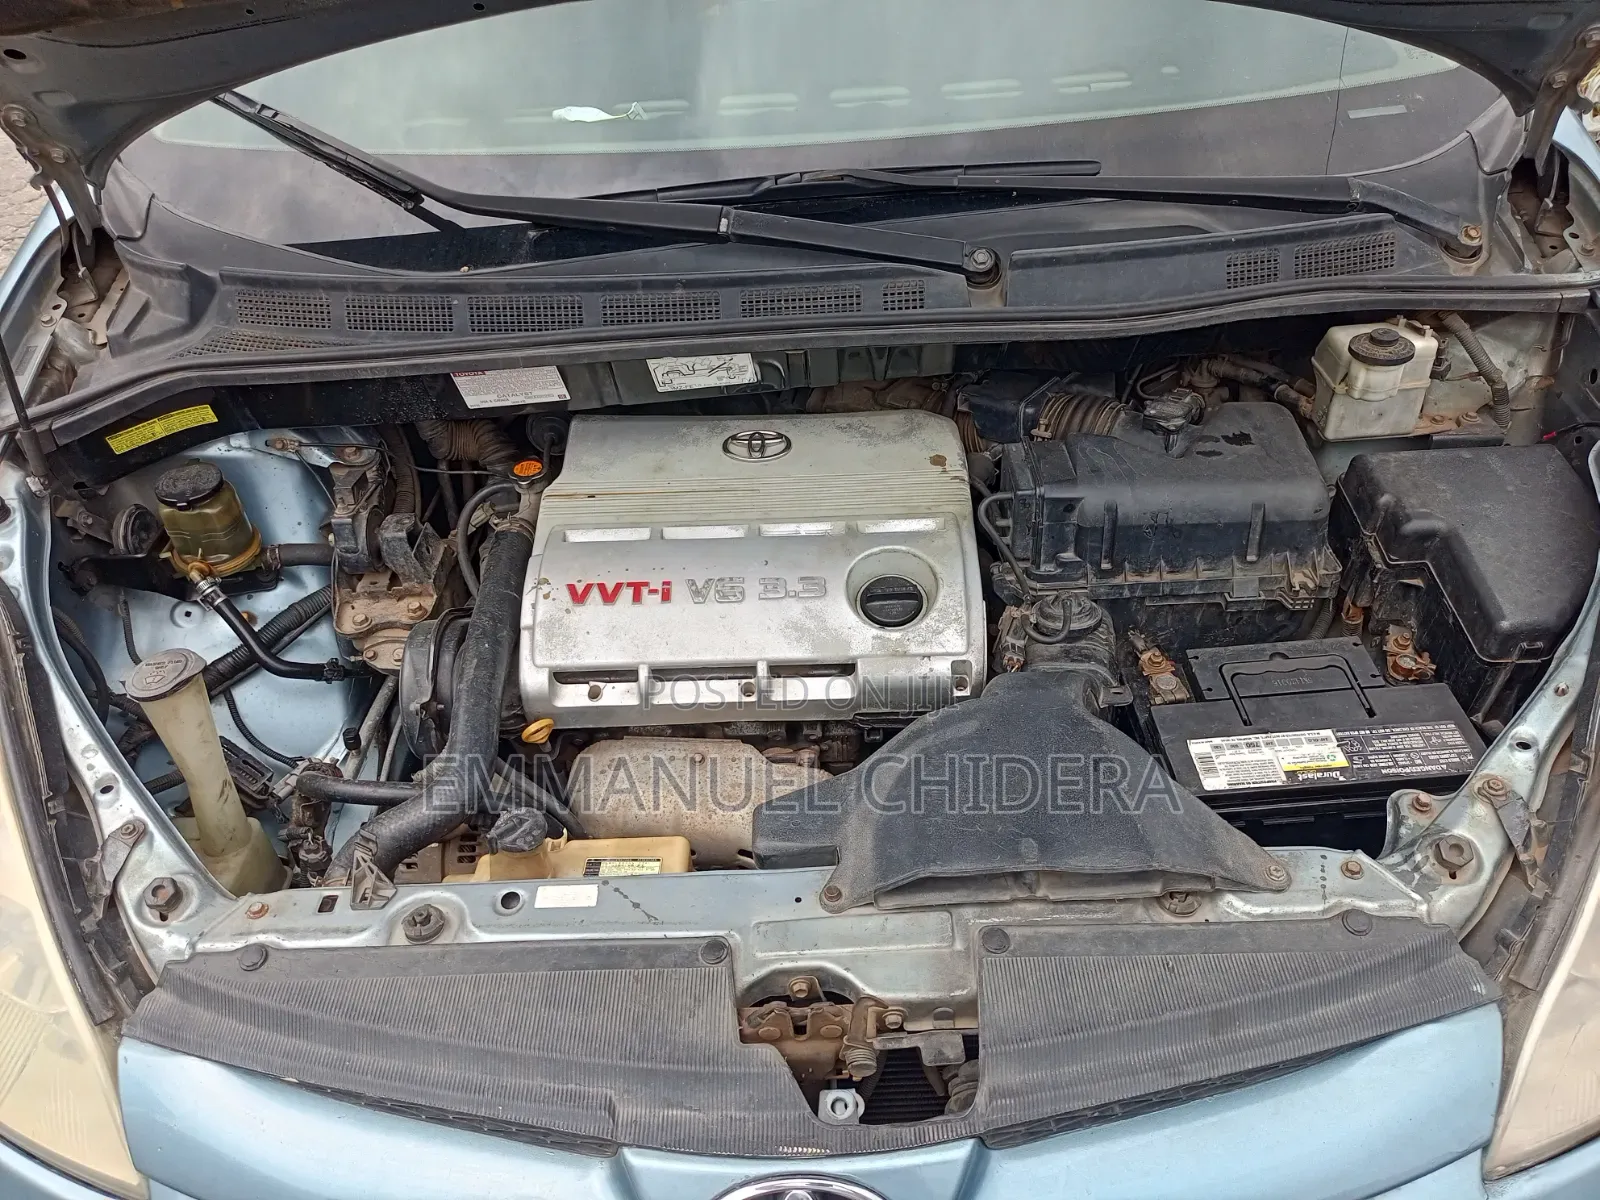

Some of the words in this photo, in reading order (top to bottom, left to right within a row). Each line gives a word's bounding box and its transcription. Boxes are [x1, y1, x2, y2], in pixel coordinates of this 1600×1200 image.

[566, 580, 672, 606] VVT-i
[685, 576, 745, 604] V6
[758, 575, 827, 600] 3.3
[1297, 770, 1341, 782] Duralast
